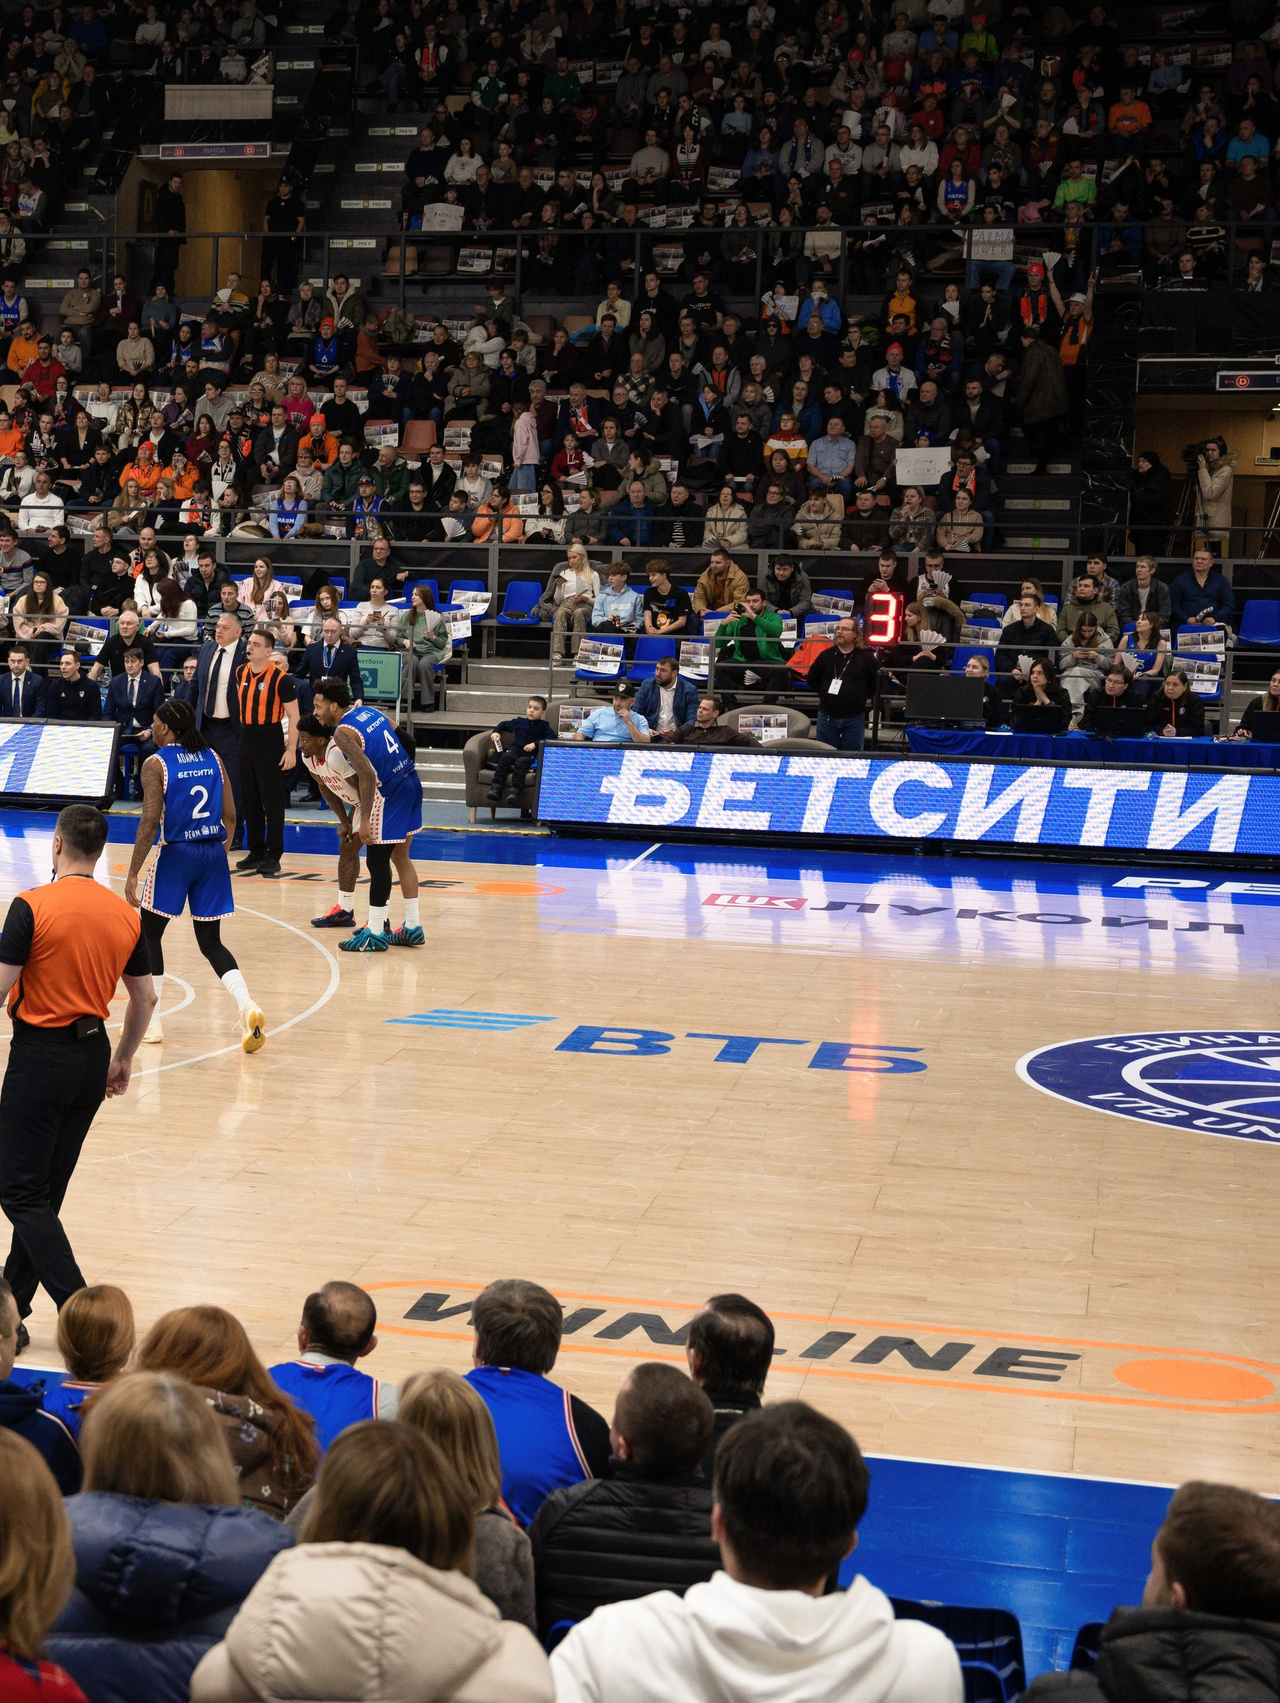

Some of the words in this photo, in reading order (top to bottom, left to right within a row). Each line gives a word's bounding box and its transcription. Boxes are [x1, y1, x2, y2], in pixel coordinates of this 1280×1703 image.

[973, 245, 1007, 255] OWER
[321, 355, 328, 363] 6
[868, 593, 897, 643] 3
[383, 729, 400, 754] 4
[177, 752, 199, 765] ADAMS
[178, 768, 214, 779] БЕТСИТИ
[190, 785, 210, 819] 2
[600, 750, 1252, 853] БЕТСИТИ
[185, 828, 201, 840] PERM
[811, 900, 1247, 935] ЛУКОЙЛ
[555, 1026, 928, 1074] ВТБ
[1088, 1092, 1190, 1119] VTB
